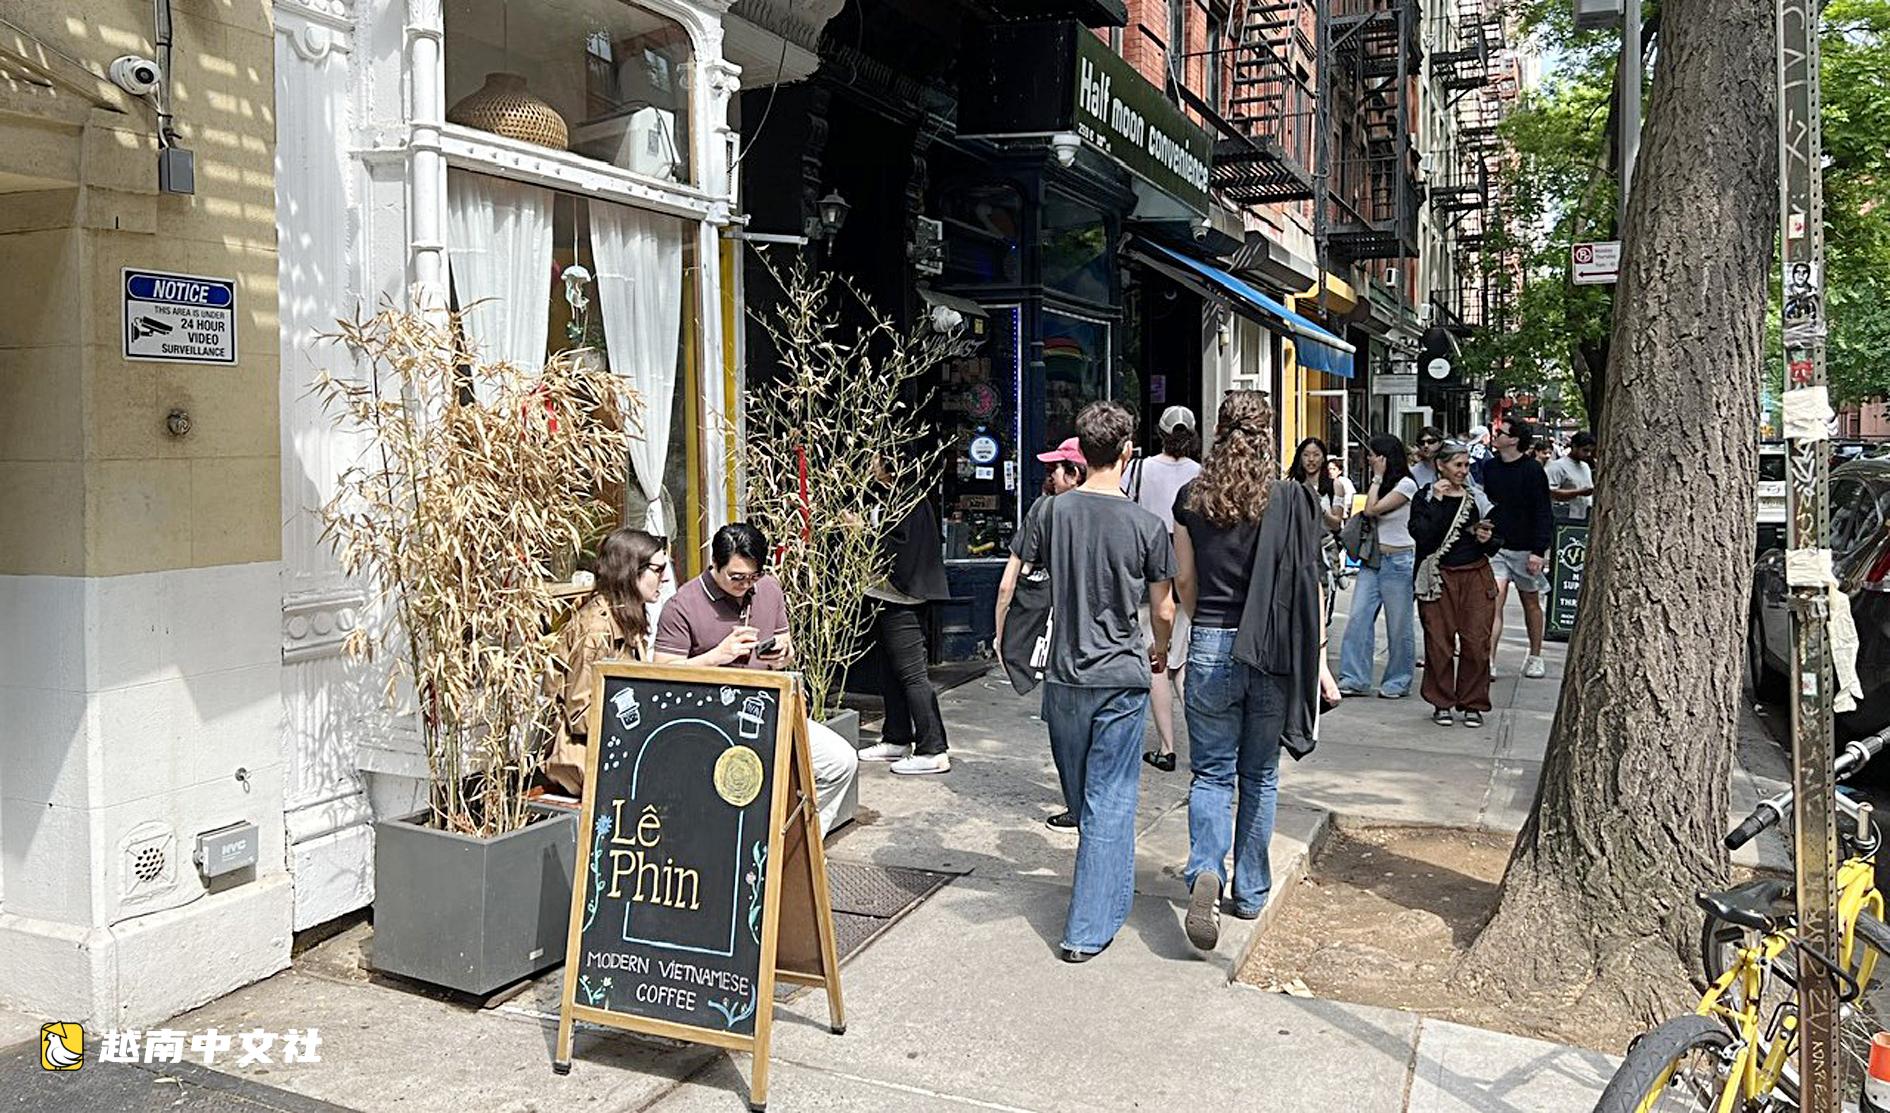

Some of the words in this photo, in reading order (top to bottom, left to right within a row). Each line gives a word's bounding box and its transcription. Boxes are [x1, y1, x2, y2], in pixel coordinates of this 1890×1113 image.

[1080, 57, 1111, 123] Half
[1111, 97, 1145, 148] moon
[1148, 125, 1209, 194] convenience
[153, 279, 210, 304] NOTICE
[154, 305, 171, 315] THIS
[172, 307, 191, 317] AREA
[193, 309, 199, 317] IS
[200, 310, 225, 319] UNDER
[181, 318, 194, 329] 24
[196, 319, 225, 332] HOUR
[162, 343, 225, 357] SURVEILLANCE
[188, 332, 219, 345] VIDEO
[611, 799, 661, 847] Lê
[607, 850, 700, 911] Phin
[586, 950, 650, 974] MODERN
[658, 960, 749, 996] VIETNAMESE
[635, 983, 697, 1012] COFFEE
